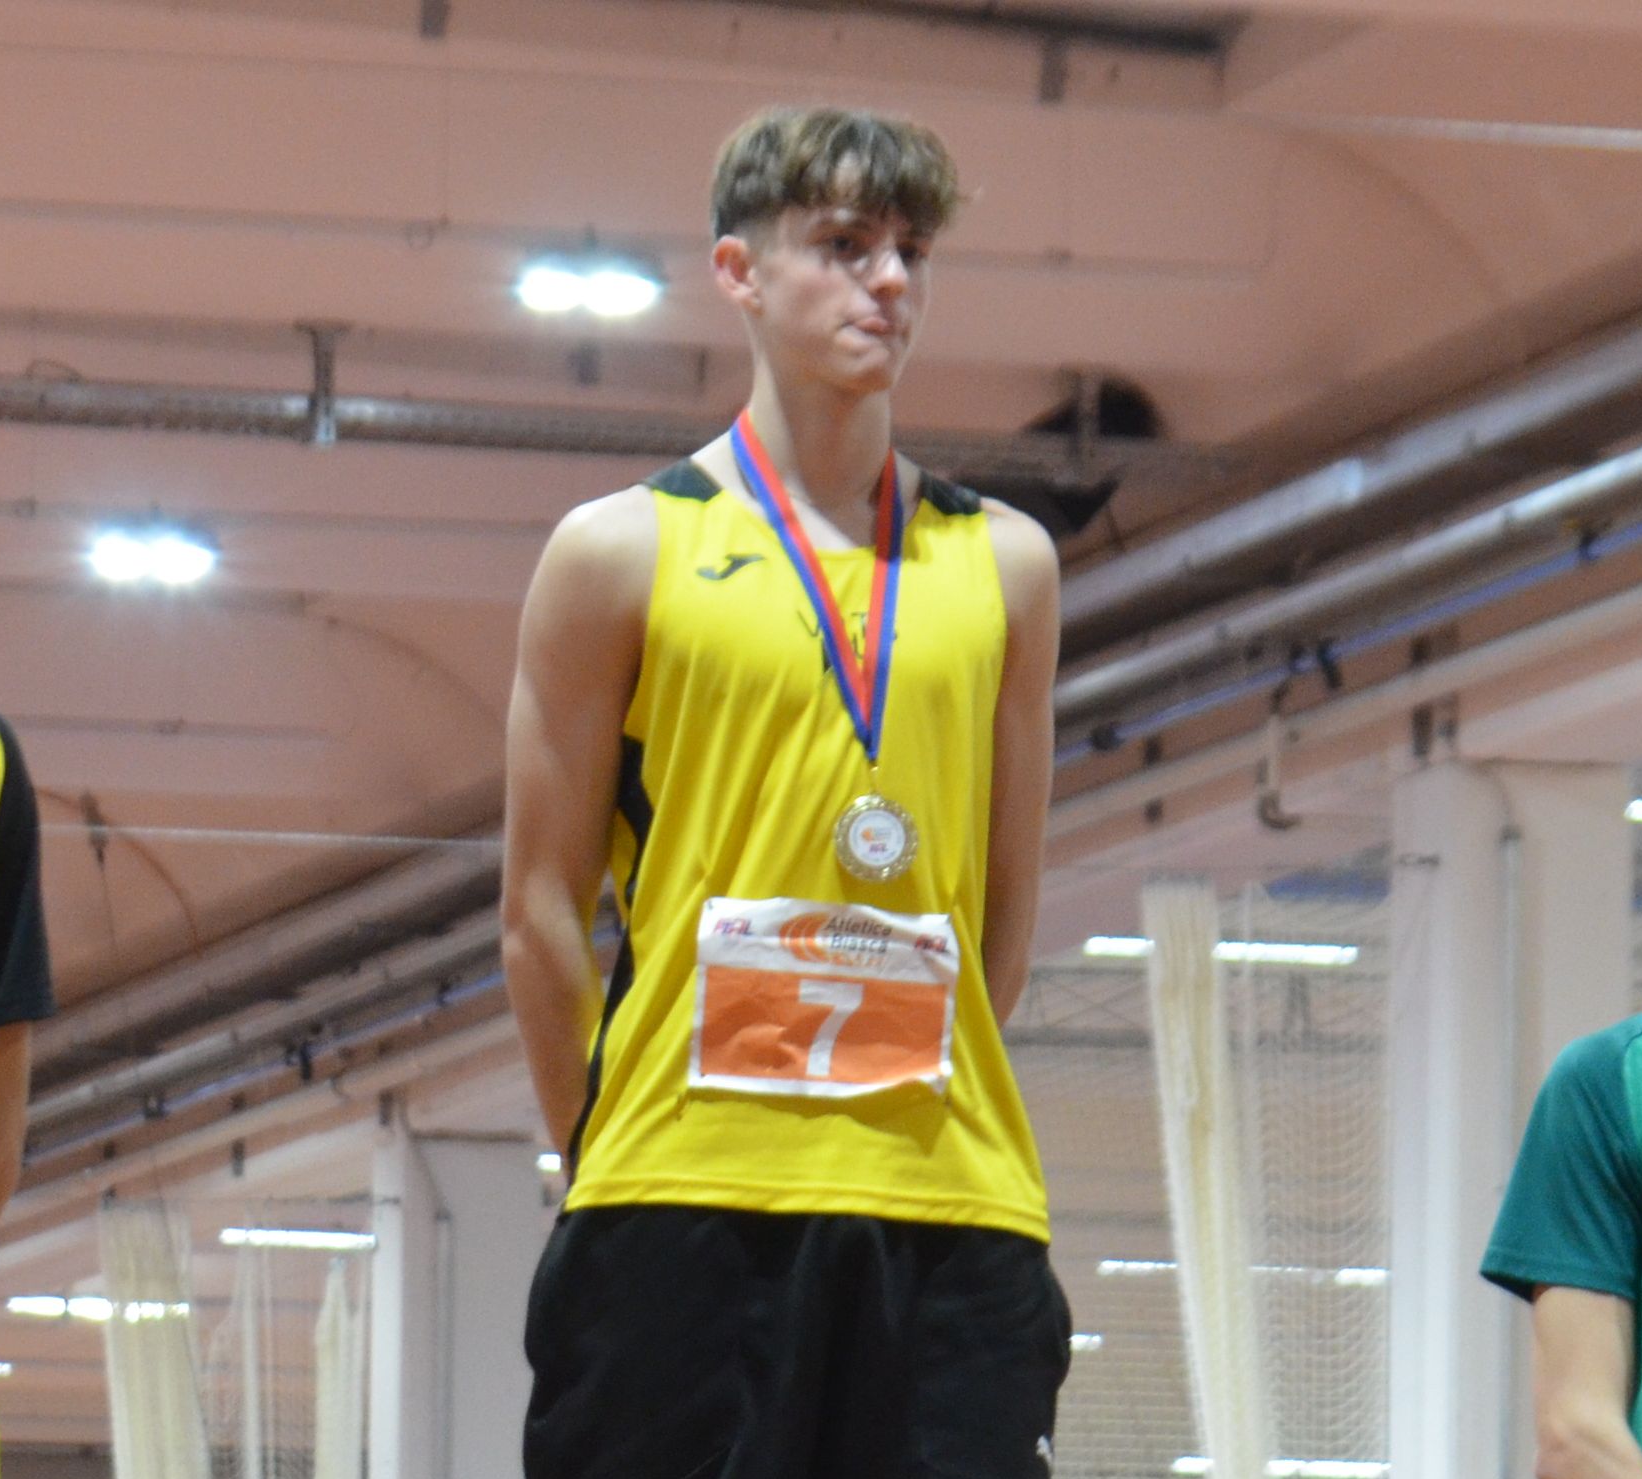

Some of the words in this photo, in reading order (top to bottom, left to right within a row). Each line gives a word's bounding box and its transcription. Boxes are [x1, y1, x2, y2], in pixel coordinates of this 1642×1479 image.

[824, 916, 892, 937] Atletica
[830, 933, 888, 954] Biasca
[799, 978, 864, 1076] 7
